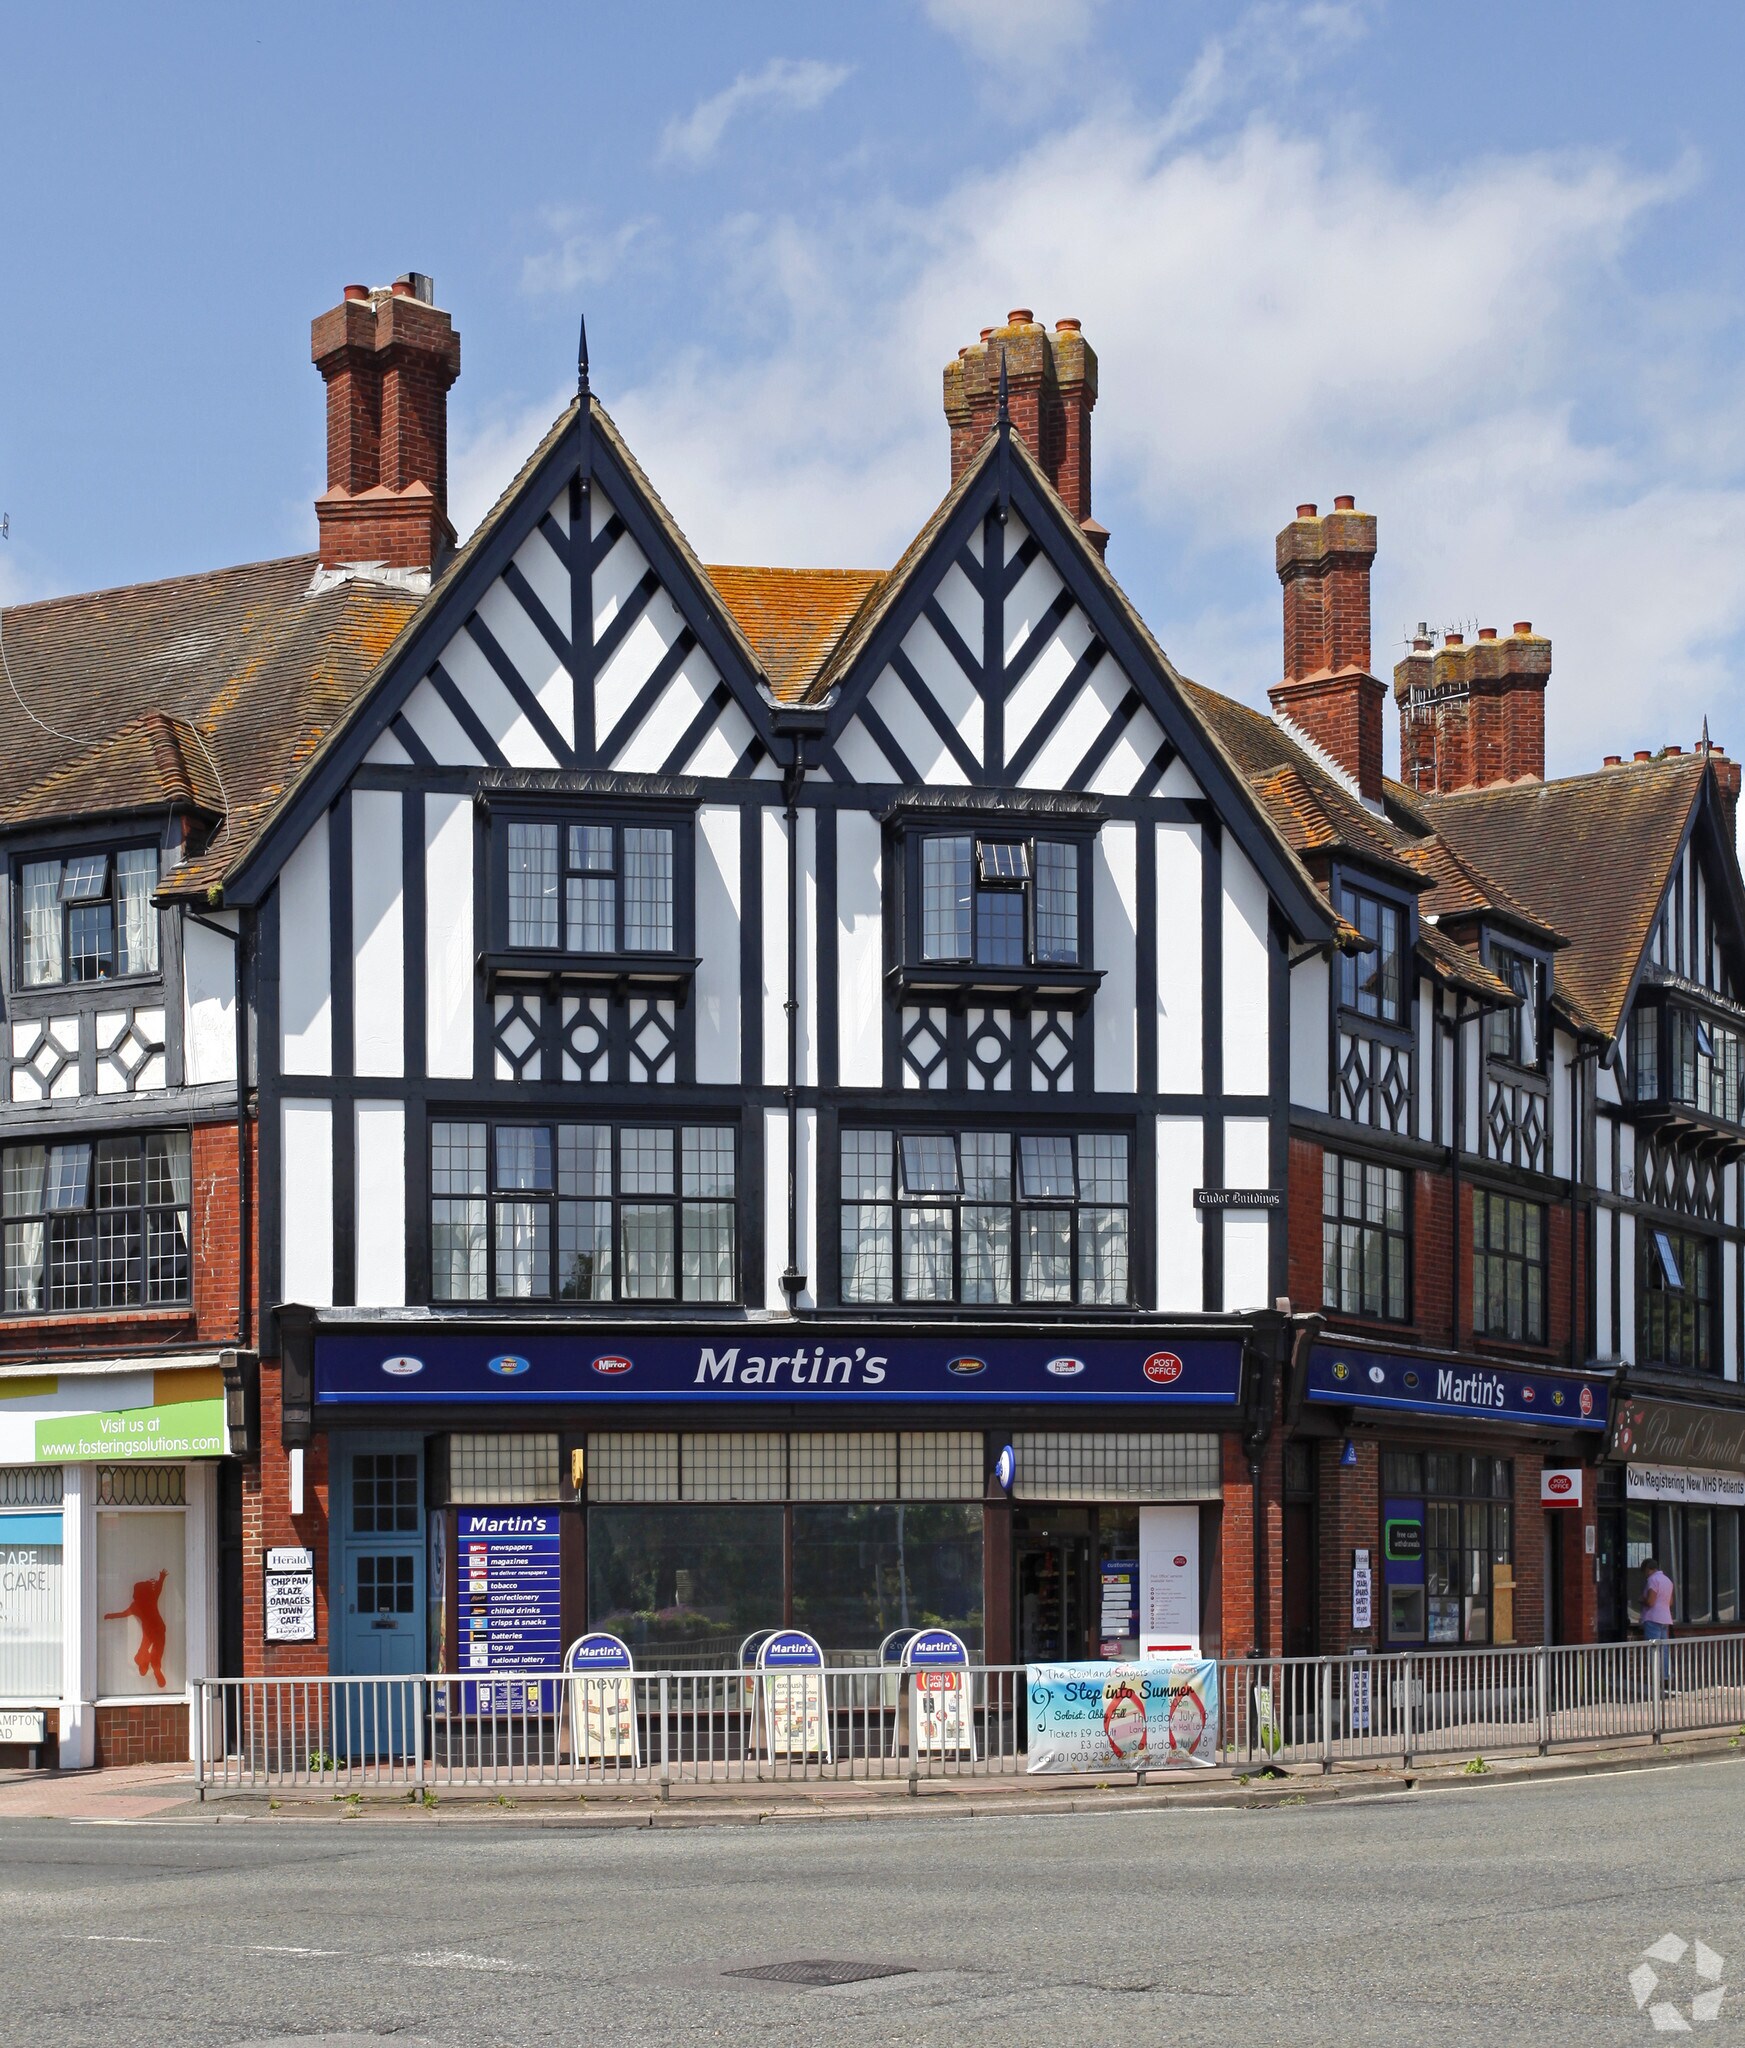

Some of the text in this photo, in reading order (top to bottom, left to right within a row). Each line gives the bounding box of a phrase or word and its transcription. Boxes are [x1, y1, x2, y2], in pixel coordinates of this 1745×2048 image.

[1199, 1192, 1280, 1206] Tudor Buildings
[598, 1360, 626, 1370] Mirror
[694, 1346, 888, 1384] Martin's
[1154, 1359, 1175, 1367] POST
[1148, 1366, 1176, 1376] OFFICE
[1436, 1368, 1504, 1407] Martin's
[100, 1418, 160, 1434] Visit us at
[1644, 1408, 1694, 1456] Pearl
[42, 1436, 220, 1456] www.fosteringsolutions.com
[1628, 1470, 1744, 1494] Now Registering New NHS Patients
[470, 1516, 546, 1532] Martin's
[490, 1544, 532, 1552] newspapers
[1394, 1540, 1420, 1548] withdrawals
[272, 1556, 306, 1564] Herald
[490, 1558, 528, 1566] magazines
[3, 1571, 50, 1591] CARE.
[272, 1577, 308, 1586] CHIP PAN
[278, 1587, 302, 1596] BLAZE
[270, 1597, 310, 1606] DAMAGES
[490, 1594, 539, 1602] confectionery
[516, 1606, 540, 1614] drinks
[280, 1616, 300, 1624] CAFE
[522, 1618, 546, 1626] snacks
[492, 1632, 522, 1640] batteries
[492, 1644, 503, 1652] top
[579, 1647, 622, 1656] Martin's
[772, 1644, 813, 1653] Martin's
[916, 1642, 958, 1652] Martin's
[492, 1656, 545, 1664] national lottery
[1046, 1670, 1064, 1679] The
[1068, 1668, 1112, 1679] Rowland
[1114, 1665, 1148, 1680] Singers
[1064, 1680, 1194, 1707] Step into Summer
[1054, 1710, 1086, 1720] Soloist:
[1133, 1712, 1175, 1723] Thursday
[1179, 1710, 1195, 1722] July
[0, 1715, 40, 1726] MPTON
[1049, 1730, 1077, 1738] Tickets
[1080, 1729, 1092, 1738] £9
[1080, 1740, 1092, 1750] £3
[1058, 1752, 1088, 1762] 01903
